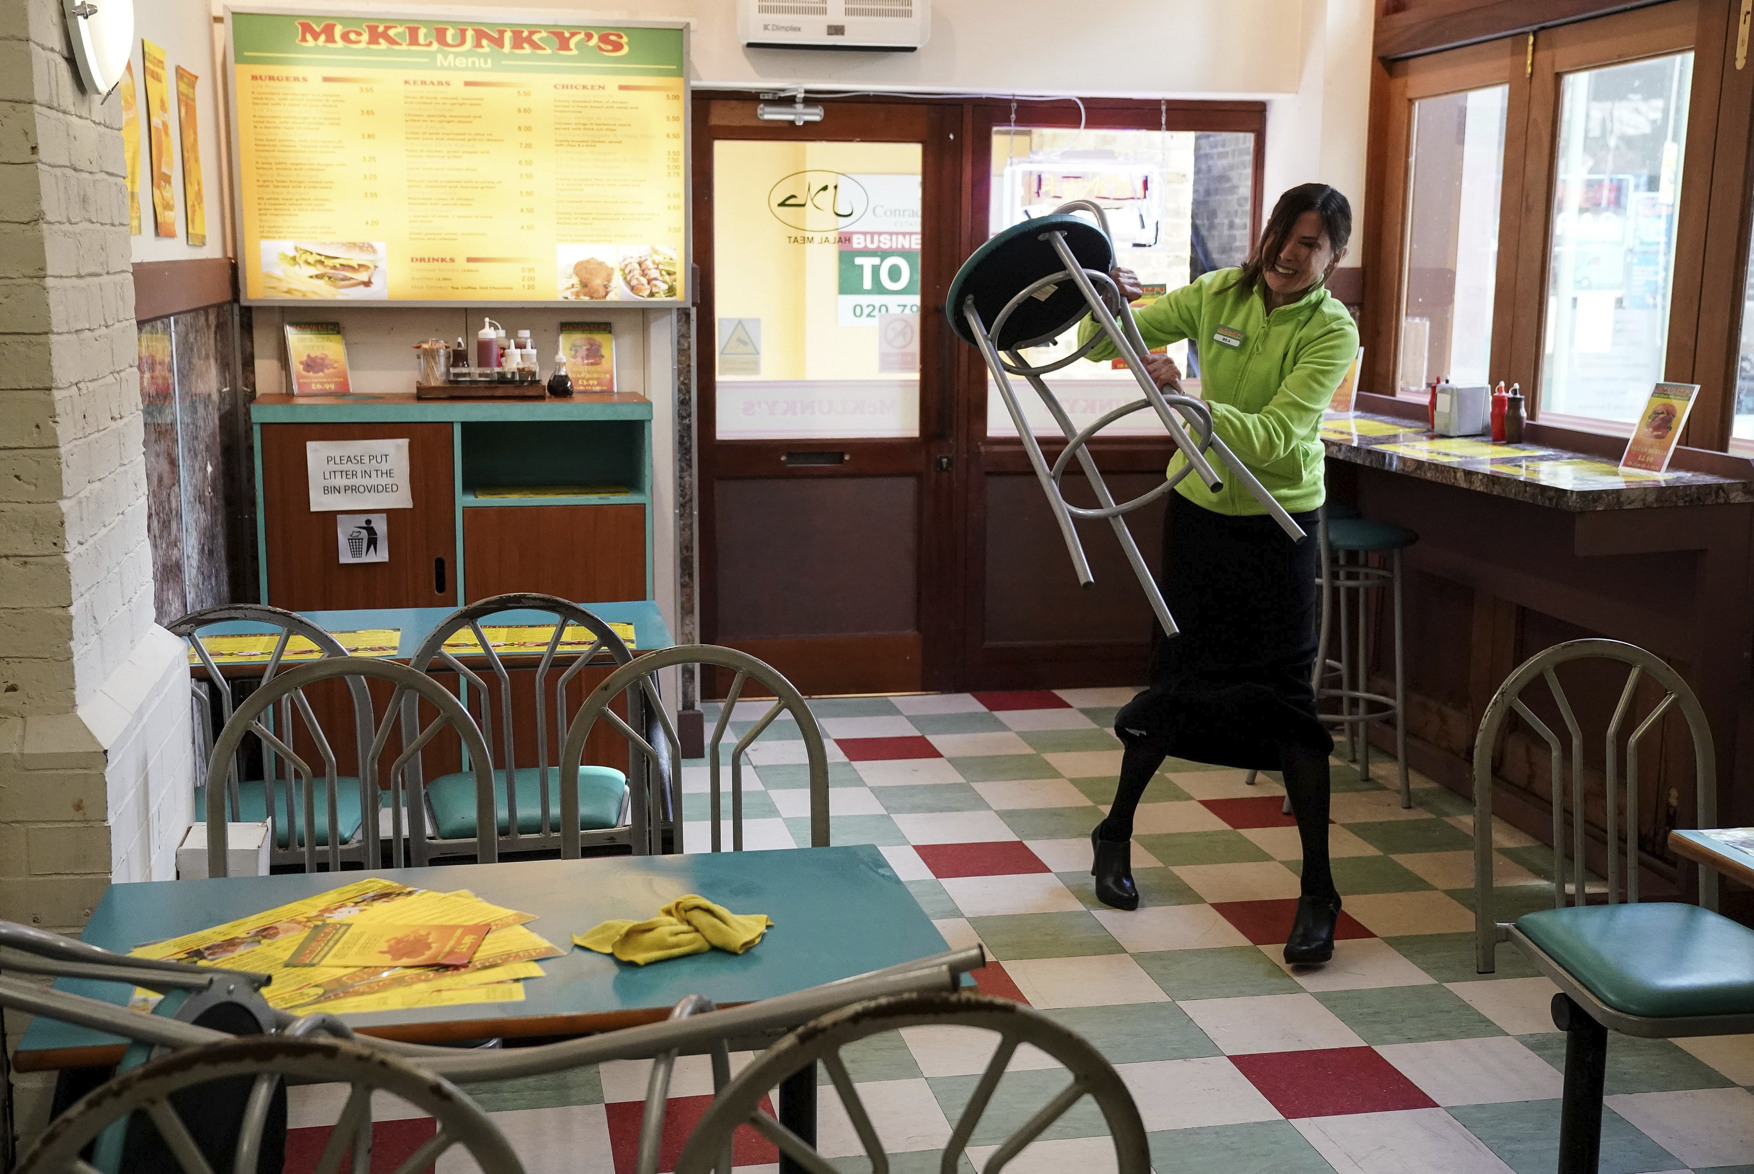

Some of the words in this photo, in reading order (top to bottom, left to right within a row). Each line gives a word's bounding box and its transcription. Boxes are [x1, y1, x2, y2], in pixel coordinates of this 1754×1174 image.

[771, 24, 802, 33] Dimplex
[296, 20, 629, 56] McKLUNKY'S
[436, 53, 492, 68] Menu
[250, 74, 308, 82] BURGERS
[852, 234, 920, 249] BUSINE
[854, 256, 910, 290] TO
[852, 304, 888, 318] 020
[326, 454, 366, 465] PLEASE
[368, 454, 389, 464] PUT
[323, 470, 358, 480] LITTER
[361, 469, 371, 479] IN
[374, 469, 394, 478] THE
[323, 485, 341, 495] BIN
[344, 483, 399, 494] PROVIDED
